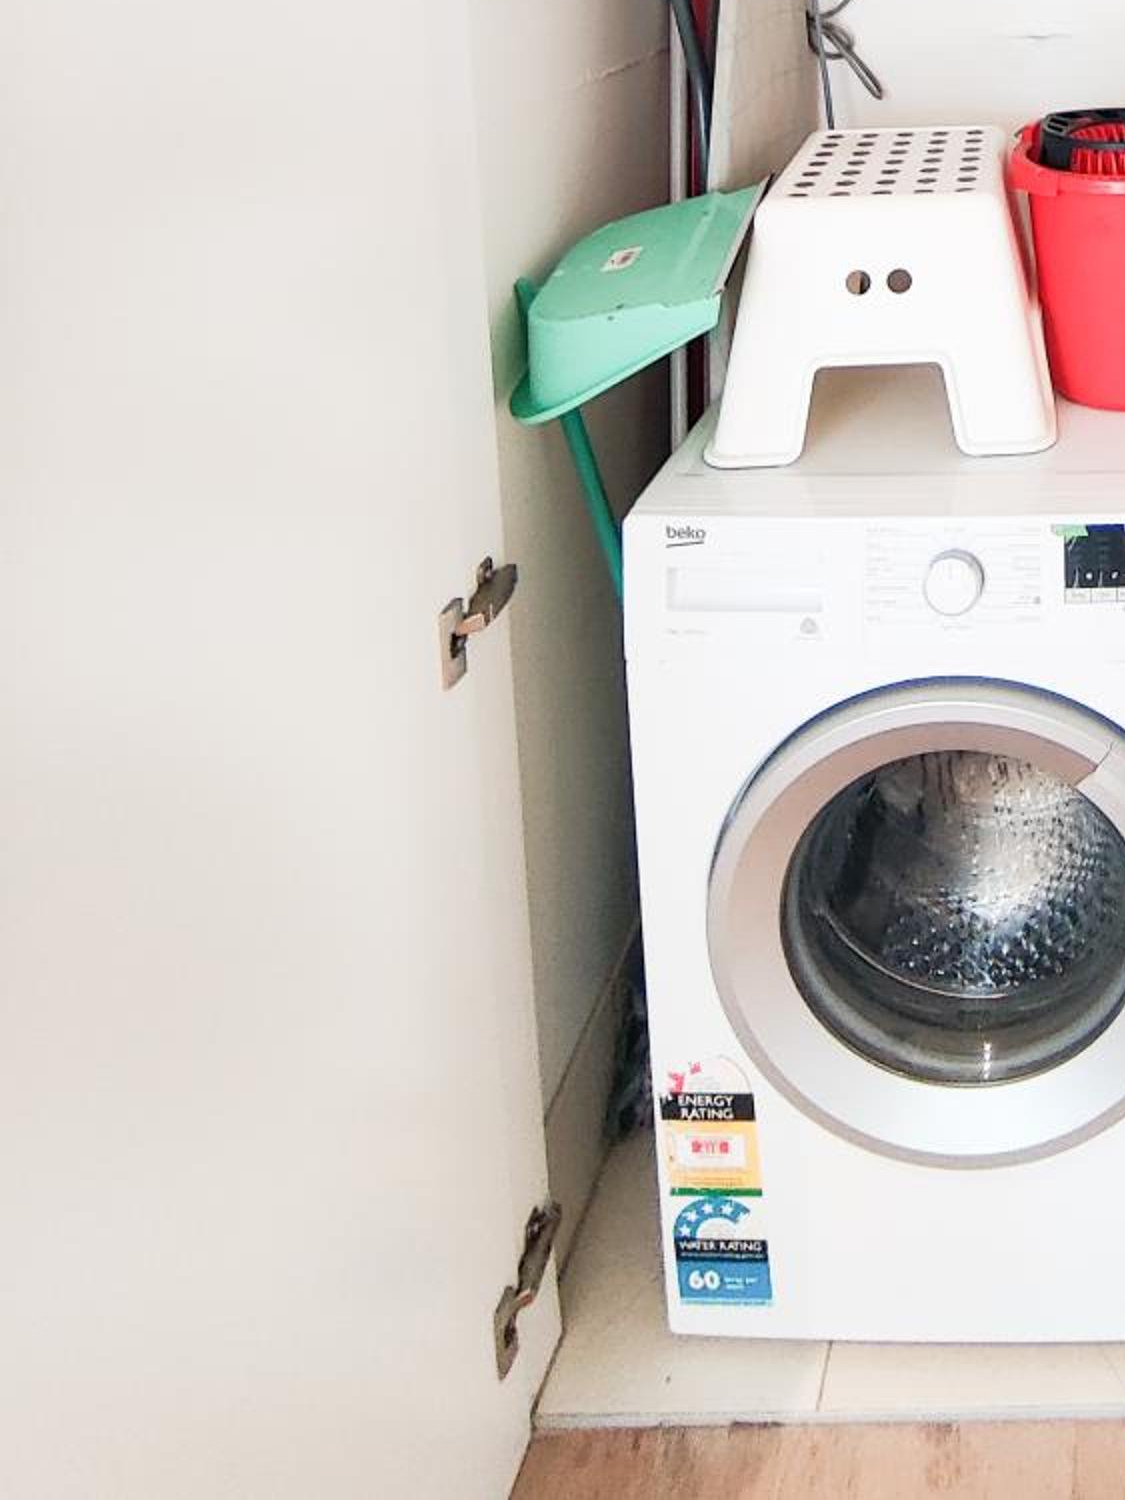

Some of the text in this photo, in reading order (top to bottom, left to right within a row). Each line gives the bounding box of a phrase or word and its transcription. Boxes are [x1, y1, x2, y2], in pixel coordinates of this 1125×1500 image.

[665, 524, 706, 540] beko
[677, 1095, 734, 1107] ENERGY
[681, 1107, 735, 1119] RATING
[679, 1241, 762, 1252] WATER RATING
[688, 1269, 721, 1290] 60
